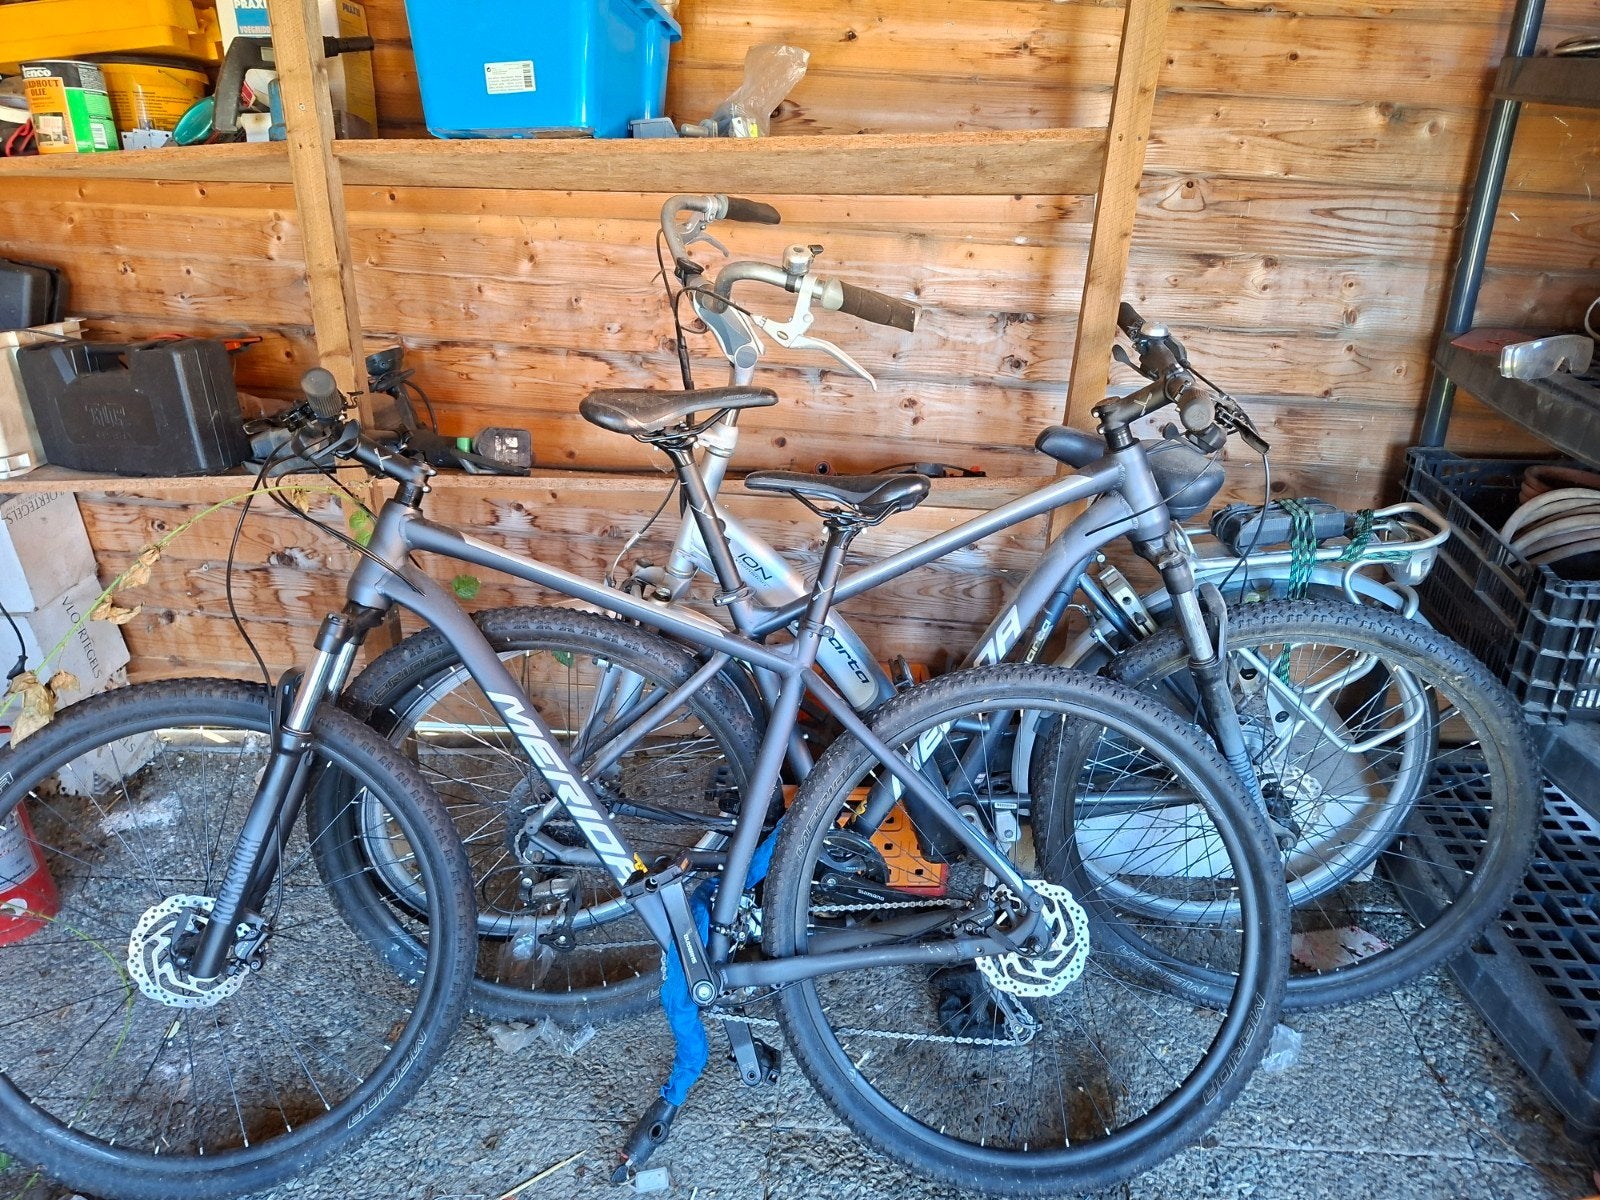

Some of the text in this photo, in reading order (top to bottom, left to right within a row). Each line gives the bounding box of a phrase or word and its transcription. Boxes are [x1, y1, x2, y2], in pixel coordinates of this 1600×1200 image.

[234, 0, 267, 9] PRAXI
[738, 553, 773, 580] ION
[211, 834, 262, 925] ROCKSHOX
[857, 888, 885, 901] SHIMANO
[683, 933, 698, 964] SHIMANO
[1203, 991, 1266, 1106] MERIDA
[347, 1027, 427, 1129] MERIDA
